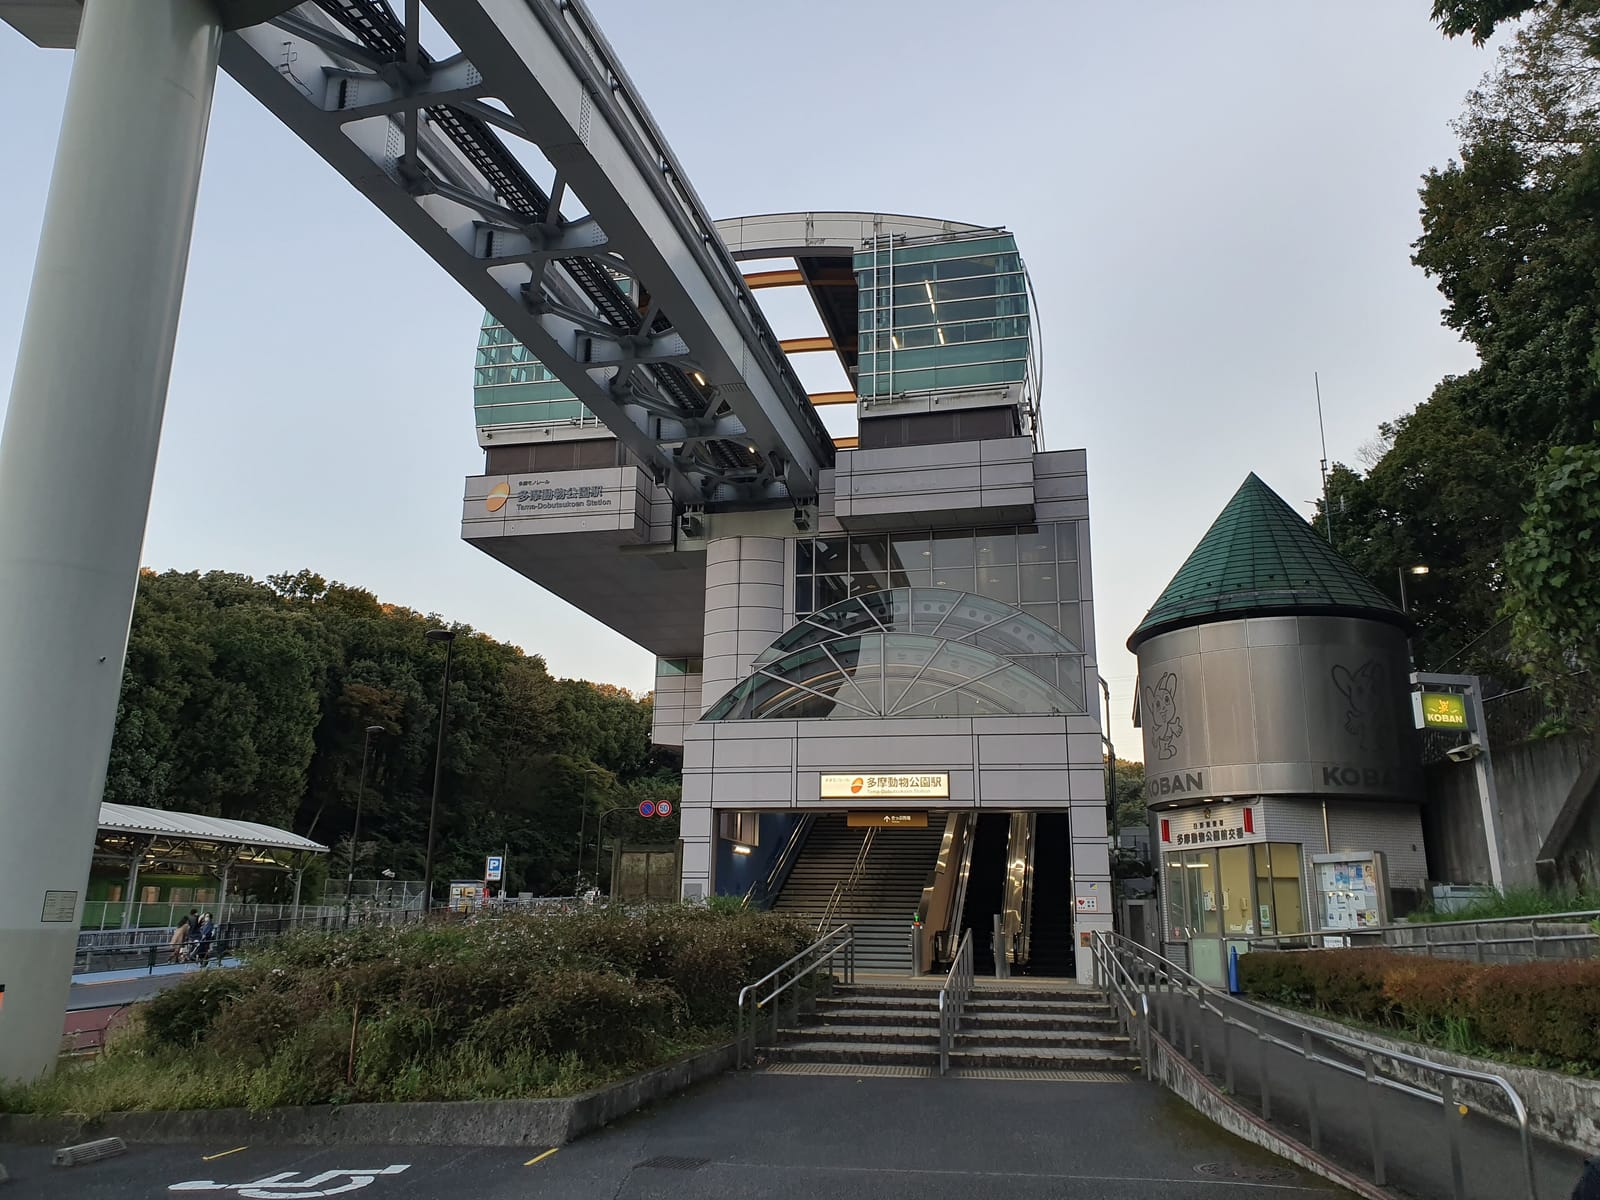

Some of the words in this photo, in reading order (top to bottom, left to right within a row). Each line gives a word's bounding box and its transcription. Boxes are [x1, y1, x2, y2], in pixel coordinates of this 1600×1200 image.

[518, 486, 603, 502] 多摩動物公園駅
[517, 501, 584, 511] Tama-Dobutsukoen
[586, 499, 612, 507] Station
[1427, 713, 1463, 724] KOBAN
[867, 776, 942, 788] 多摩動物公園駅
[1322, 766, 1397, 786] KOBA
[490, 860, 499, 870] P
